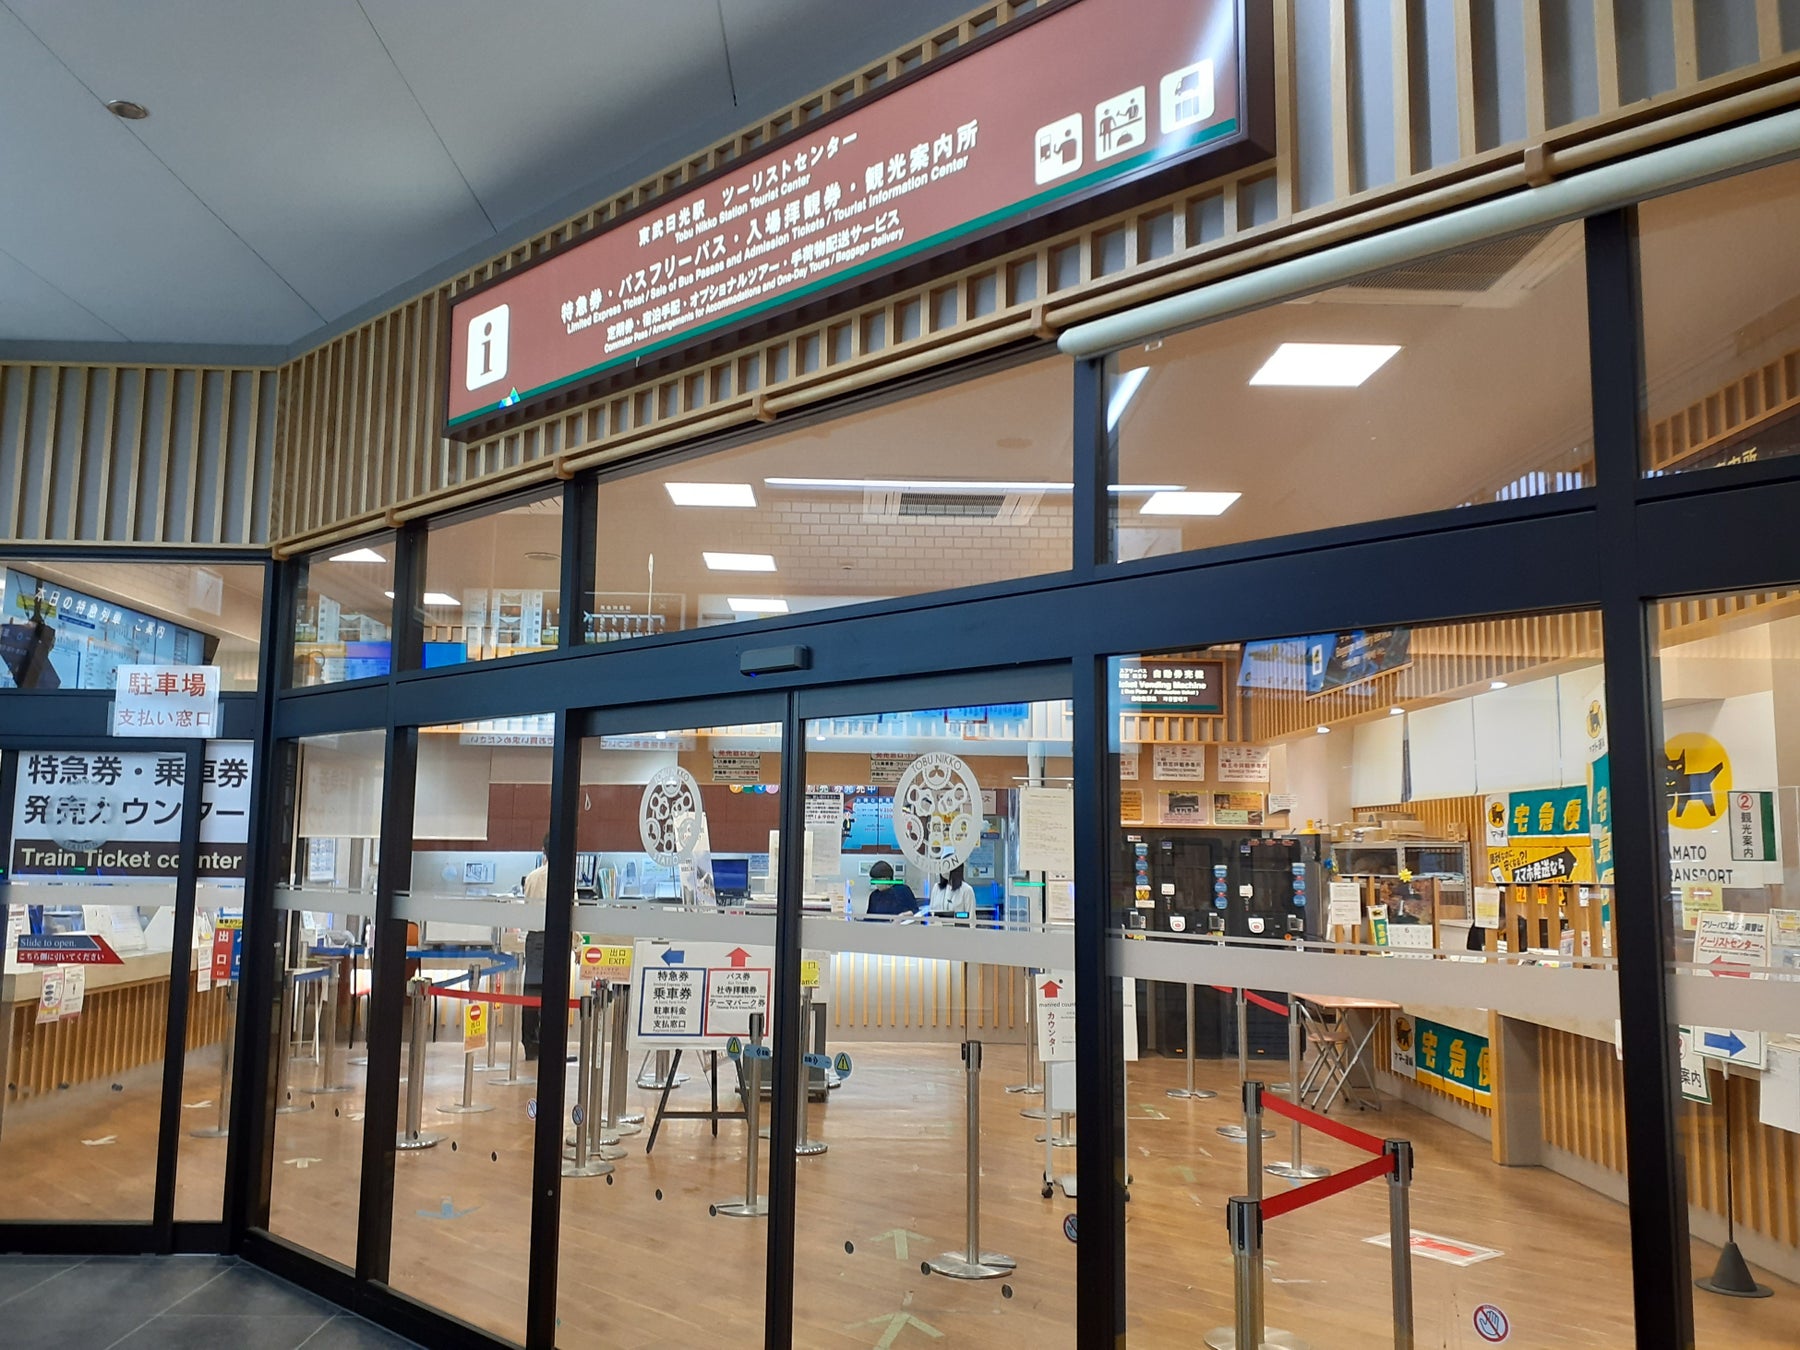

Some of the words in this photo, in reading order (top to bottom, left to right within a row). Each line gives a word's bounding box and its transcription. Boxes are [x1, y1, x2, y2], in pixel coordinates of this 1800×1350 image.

[638, 198, 706, 247] 東武日光駅
[722, 132, 858, 207] ツーリストセンター
[675, 227, 694, 244] Tobu
[695, 217, 717, 237] Nikko
[719, 204, 748, 225] Station
[749, 189, 779, 210] Tourist
[780, 173, 811, 196] Center
[567, 313, 592, 334] Limited
[593, 303, 622, 324] Express
[622, 294, 646, 312] Ticket
[650, 284, 667, 300] Sale
[668, 281, 678, 293] of
[678, 273, 694, 289] Bus
[696, 262, 724, 281] Passes
[726, 252, 742, 268] and
[743, 233, 790, 260] Admission
[791, 217, 825, 241] Tickets
[832, 201, 867, 222] Tourist
[868, 174, 928, 208] Information
[930, 155, 969, 182] Center
[604, 336, 634, 354] Commuter
[634, 329, 649, 342] Pass
[652, 310, 695, 335] Arrangements
[695, 306, 705, 316] for
[762, 278, 776, 293] and
[809, 256, 830, 273] Tours
[835, 242, 870, 264] Baggage
[871, 227, 904, 250] Delivery
[128, 673, 206, 697] 駐車場
[1172, 681, 1207, 689] Machine
[118, 709, 212, 728] 支払い窓口
[912, 753, 934, 773] TOBU
[935, 753, 962, 771] NIKKO
[1513, 798, 1582, 833] 宅急便
[1740, 811, 1754, 858] 観光案内
[21, 848, 76, 869] Train
[84, 849, 150, 869] Ticket
[157, 852, 242, 870] conter
[1671, 845, 1707, 860] MATO
[1514, 857, 1566, 882] スマホ発送なら
[1671, 868, 1733, 885] ANSPORT
[20, 938, 41, 947] Slide
[43, 939, 52, 947] to
[53, 940, 77, 949] open.
[1700, 936, 1766, 951] ツーリストセンターへ
[19, 952, 105, 962] こちら側に引いてください
[609, 948, 626, 957] 出口
[657, 970, 689, 981] 特急券
[726, 972, 751, 981] バス券
[652, 987, 692, 1000] 乗車券
[653, 1006, 687, 1015] 駐車料金
[709, 998, 766, 1008] テーマパーク券
[653, 1020, 687, 1029] 支払窓口
[1047, 1011, 1057, 1055] カウンター
